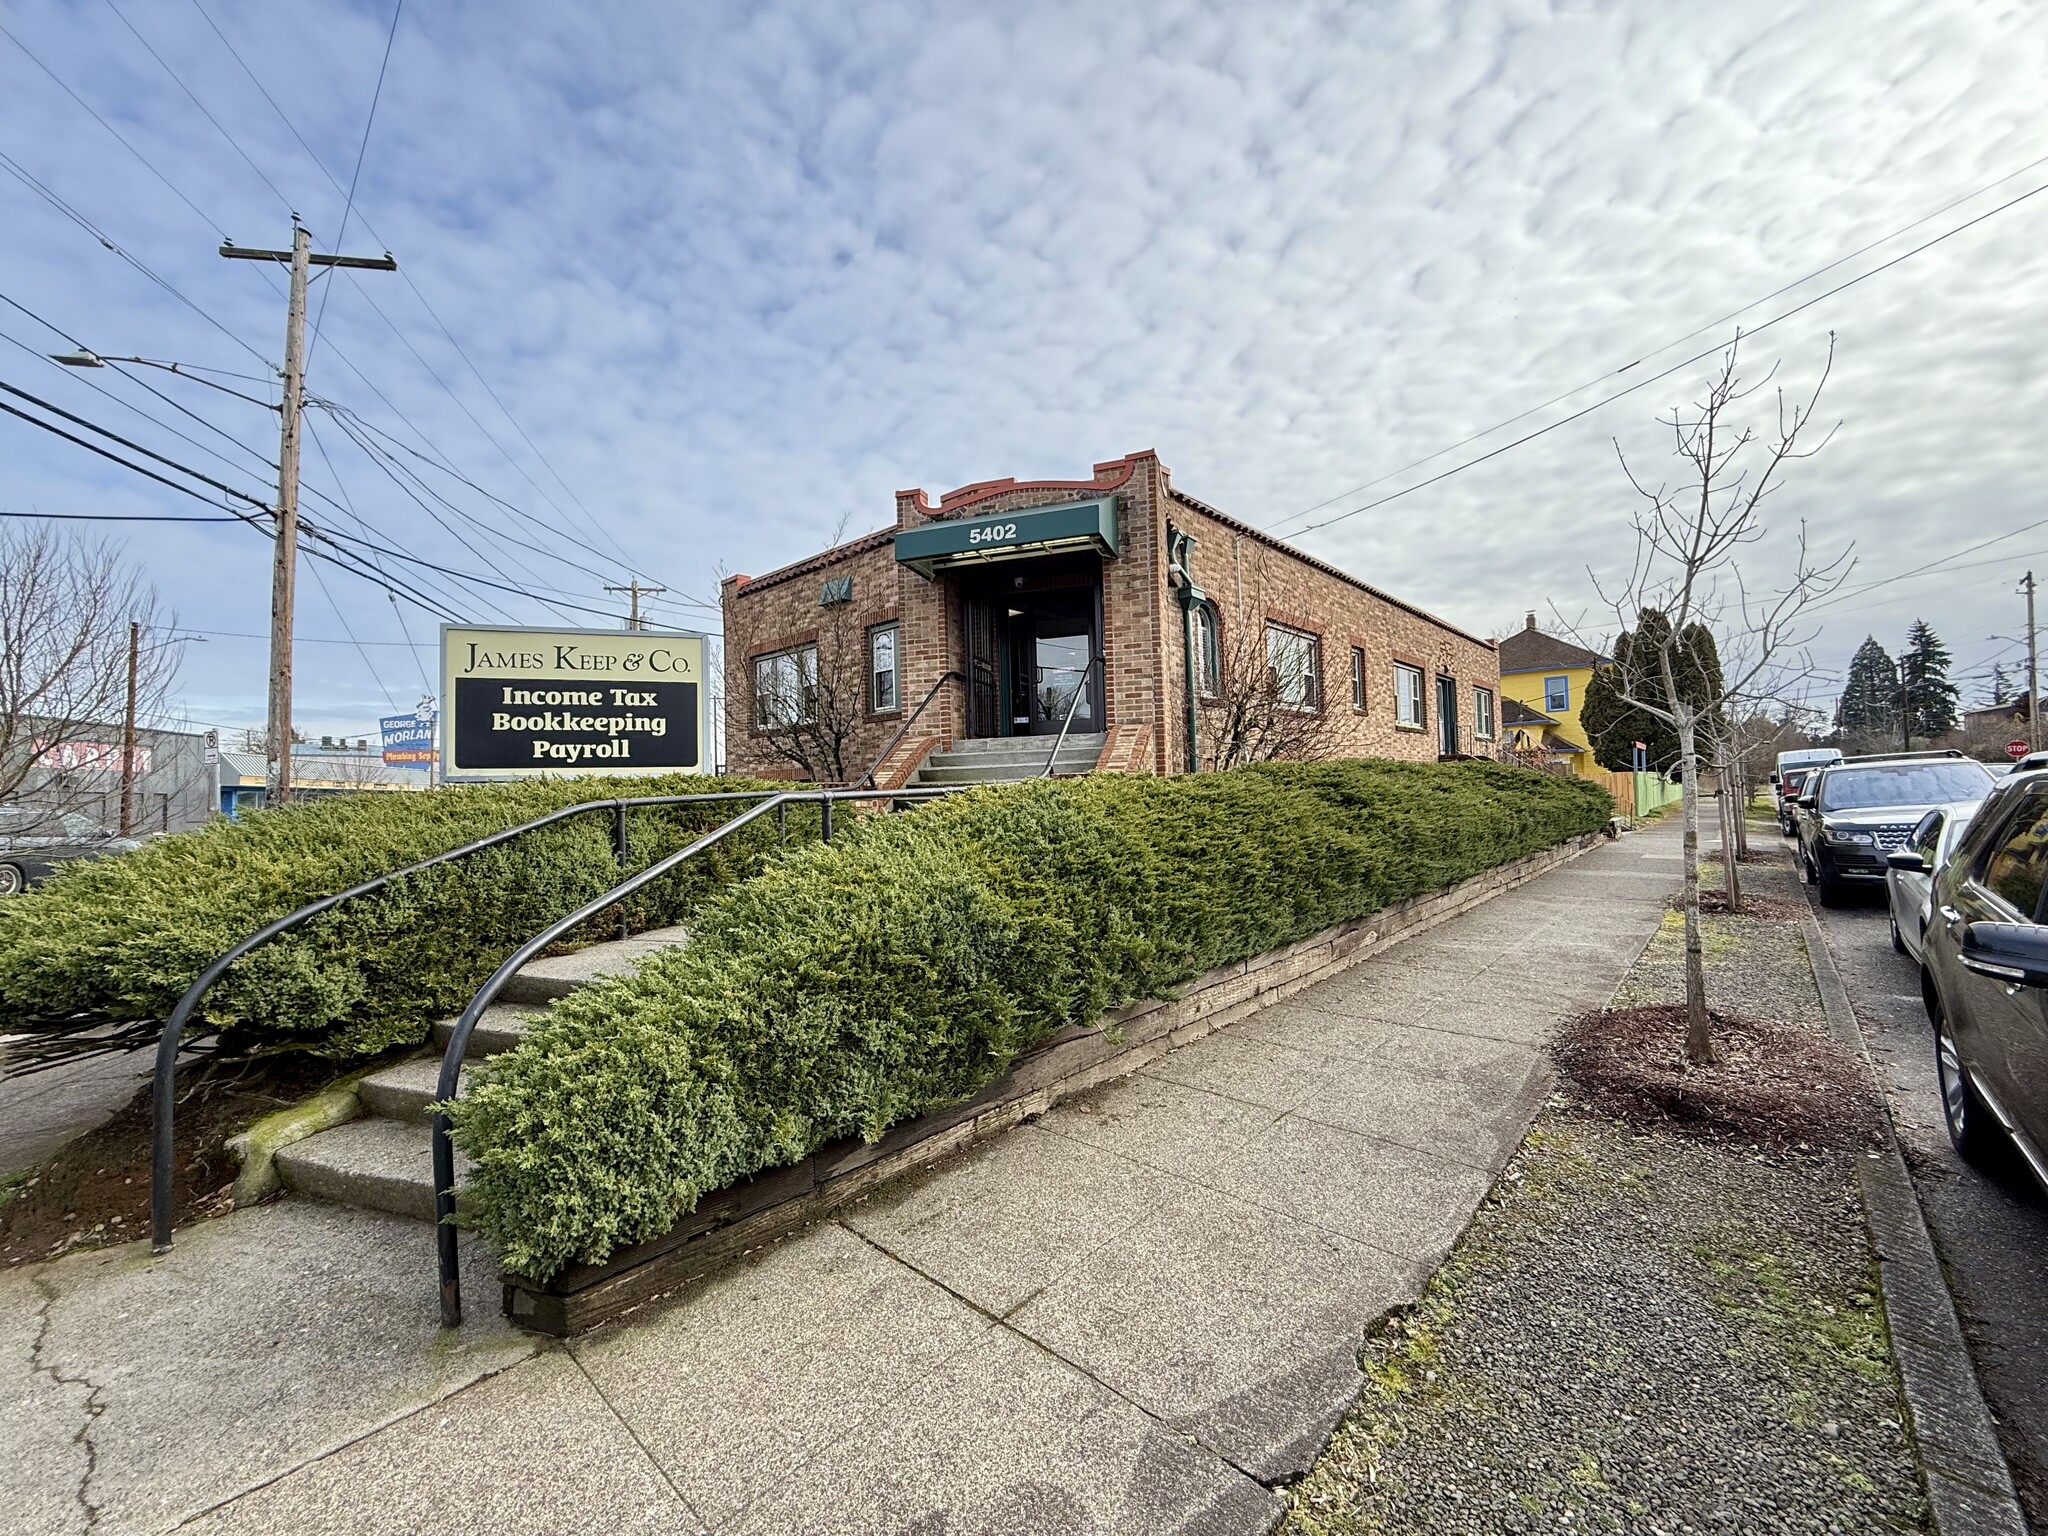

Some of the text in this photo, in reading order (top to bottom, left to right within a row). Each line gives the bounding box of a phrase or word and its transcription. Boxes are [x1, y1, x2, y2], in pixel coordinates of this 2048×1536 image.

[969, 523, 1017, 544] 5402
[464, 643, 544, 673] JAMES
[553, 645, 617, 671] KEEP
[622, 653, 644, 672] &
[502, 687, 658, 707] Income Tax
[383, 720, 417, 729] GEORGE
[492, 712, 667, 737] Bookkeeping
[384, 729, 432, 747] MORLAN
[38, 743, 151, 773] CARPT
[386, 752, 417, 762] Plumbing
[532, 739, 631, 763] Payroll
[2007, 745, 2029, 753] STOP
